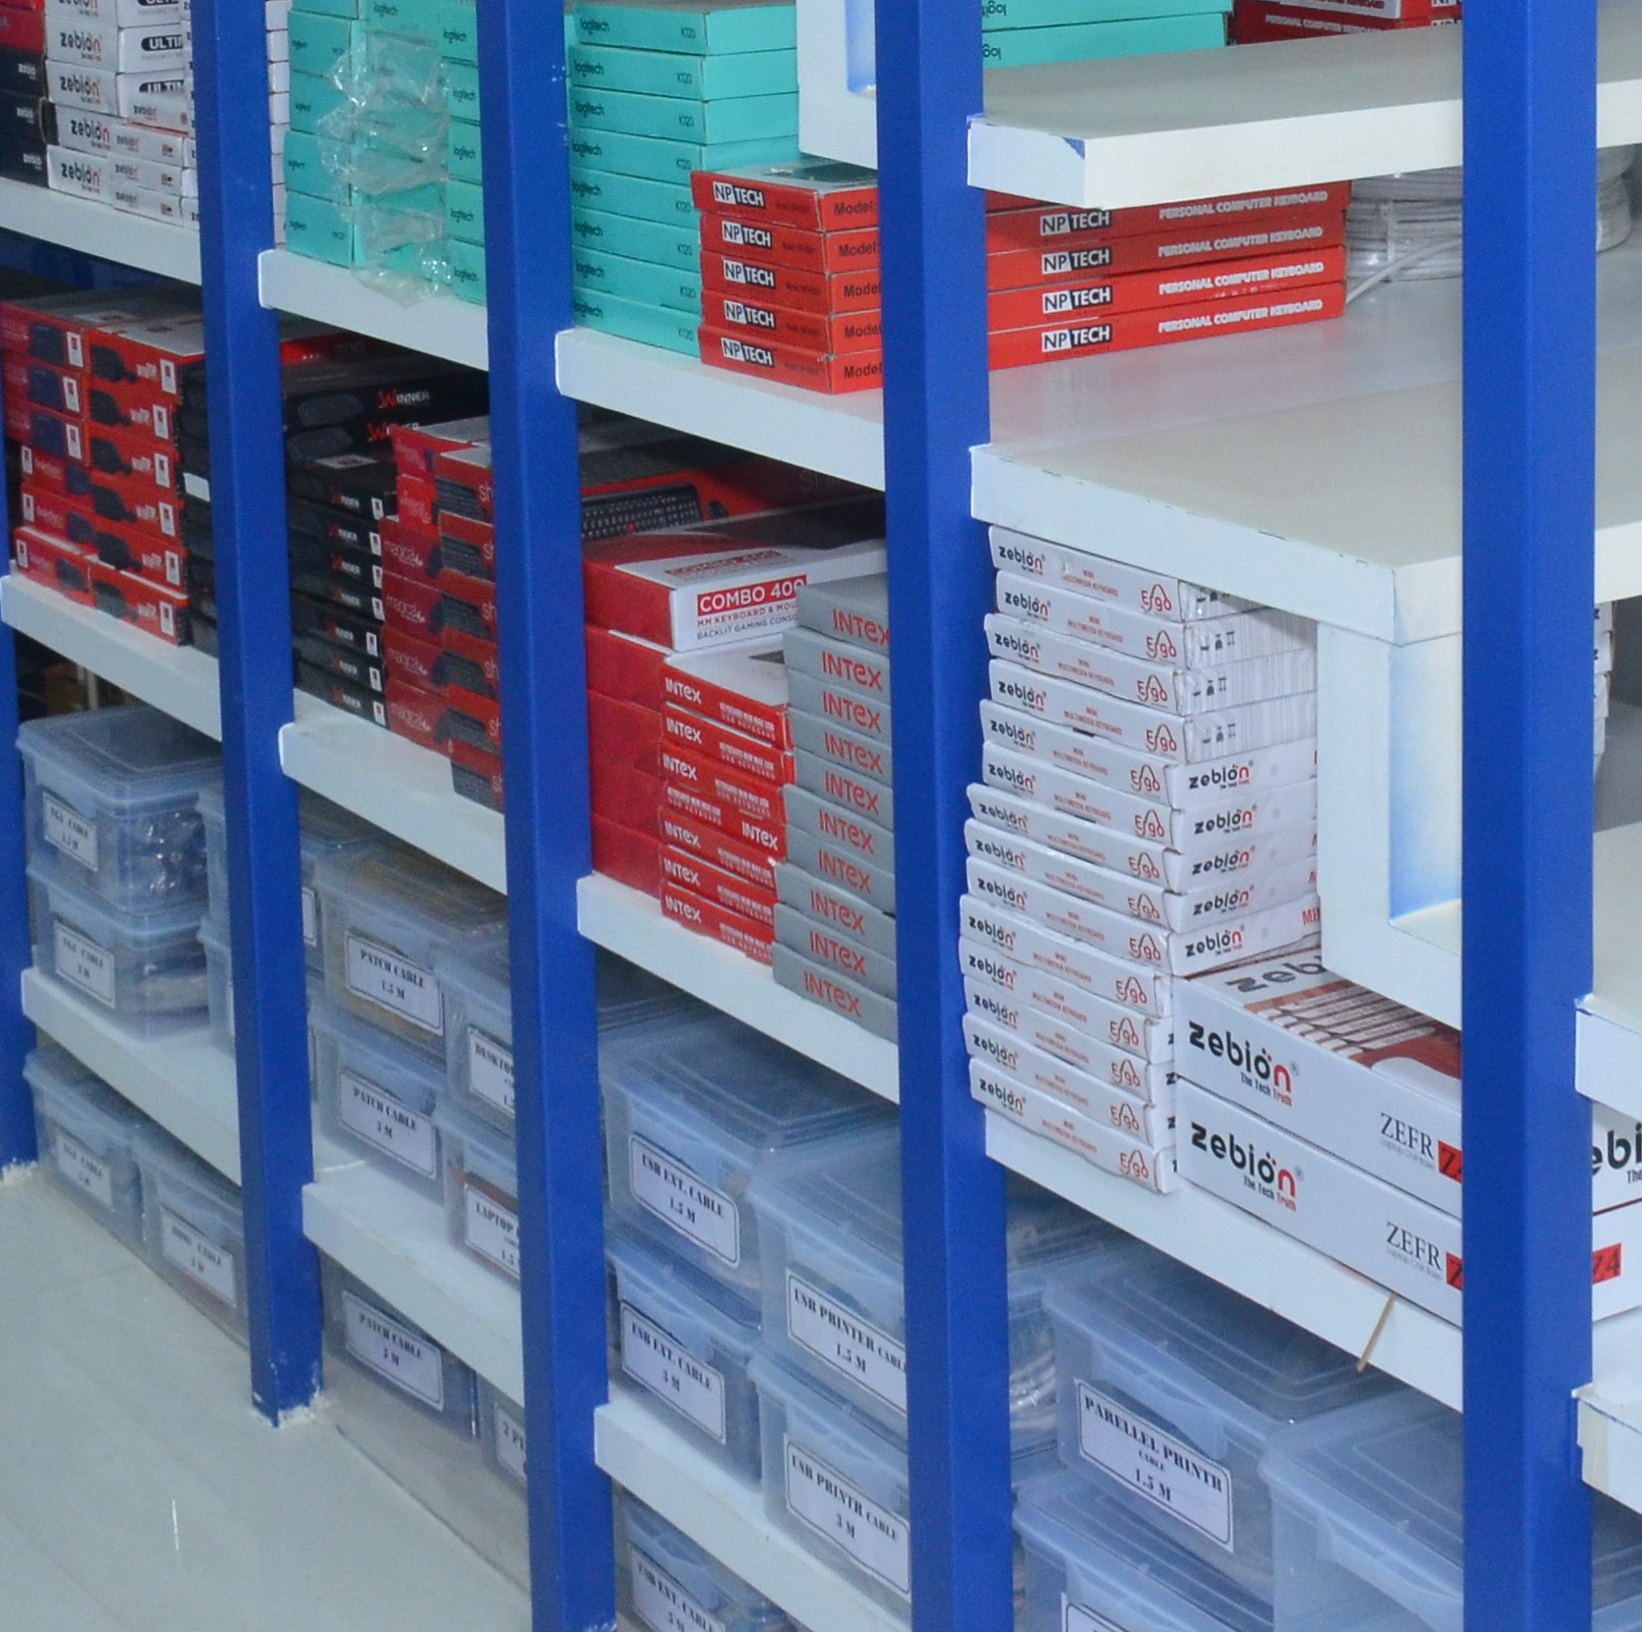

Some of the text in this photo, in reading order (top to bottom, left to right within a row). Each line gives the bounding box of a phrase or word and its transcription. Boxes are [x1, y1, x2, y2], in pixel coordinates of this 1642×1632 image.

[443, 29, 467, 43] logitech
[580, 18, 609, 35] logitech
[576, 102, 604, 118] logitech
[1160, 191, 1327, 219] PERSONAL COMPUTER KEYBOARD
[574, 221, 602, 237] logitech
[1159, 262, 1324, 295] PERSONAL COMPUTER KEYBOARD
[1159, 300, 1322, 333] PERSONAL COMPUTER KEYBOARD
[700, 589, 765, 612] COMBO
[1142, 584, 1171, 611] Ergo
[698, 627, 731, 639] BACKLIT
[735, 620, 767, 632] GAMING
[715, 608, 765, 623] KEYBOARD
[1137, 675, 1168, 702] Ergo
[361, 949, 423, 988] PATCH CABLE
[382, 980, 405, 999] 1.5 M
[1116, 977, 1146, 1003] Ergo
[1241, 1072, 1292, 1106] The Tech Truth
[354, 1087, 417, 1130] PATCH CABLE
[1381, 1112, 1433, 1159] ZEFR
[1120, 1150, 1149, 1178] Ergo
[642, 1154, 722, 1216] USB EXT. CABLE
[1244, 1175, 1296, 1212] The Tech Truth
[476, 1202, 514, 1233] LAPTOP
[670, 1197, 695, 1223] 1.5 M
[1386, 1221, 1441, 1269] ZEFR
[795, 1288, 816, 1313] USB
[820, 1307, 874, 1352] PRINTER
[632, 1322, 711, 1390] USB EXT. CABLE
[836, 1343, 866, 1373] 1.5 M
[1085, 1396, 1222, 1493] PARELLEL PRINTR
[1138, 1449, 1164, 1471] CABLE
[792, 1454, 897, 1541] USB PRINTR CABLE
[1135, 1468, 1171, 1502] 1.5 M
